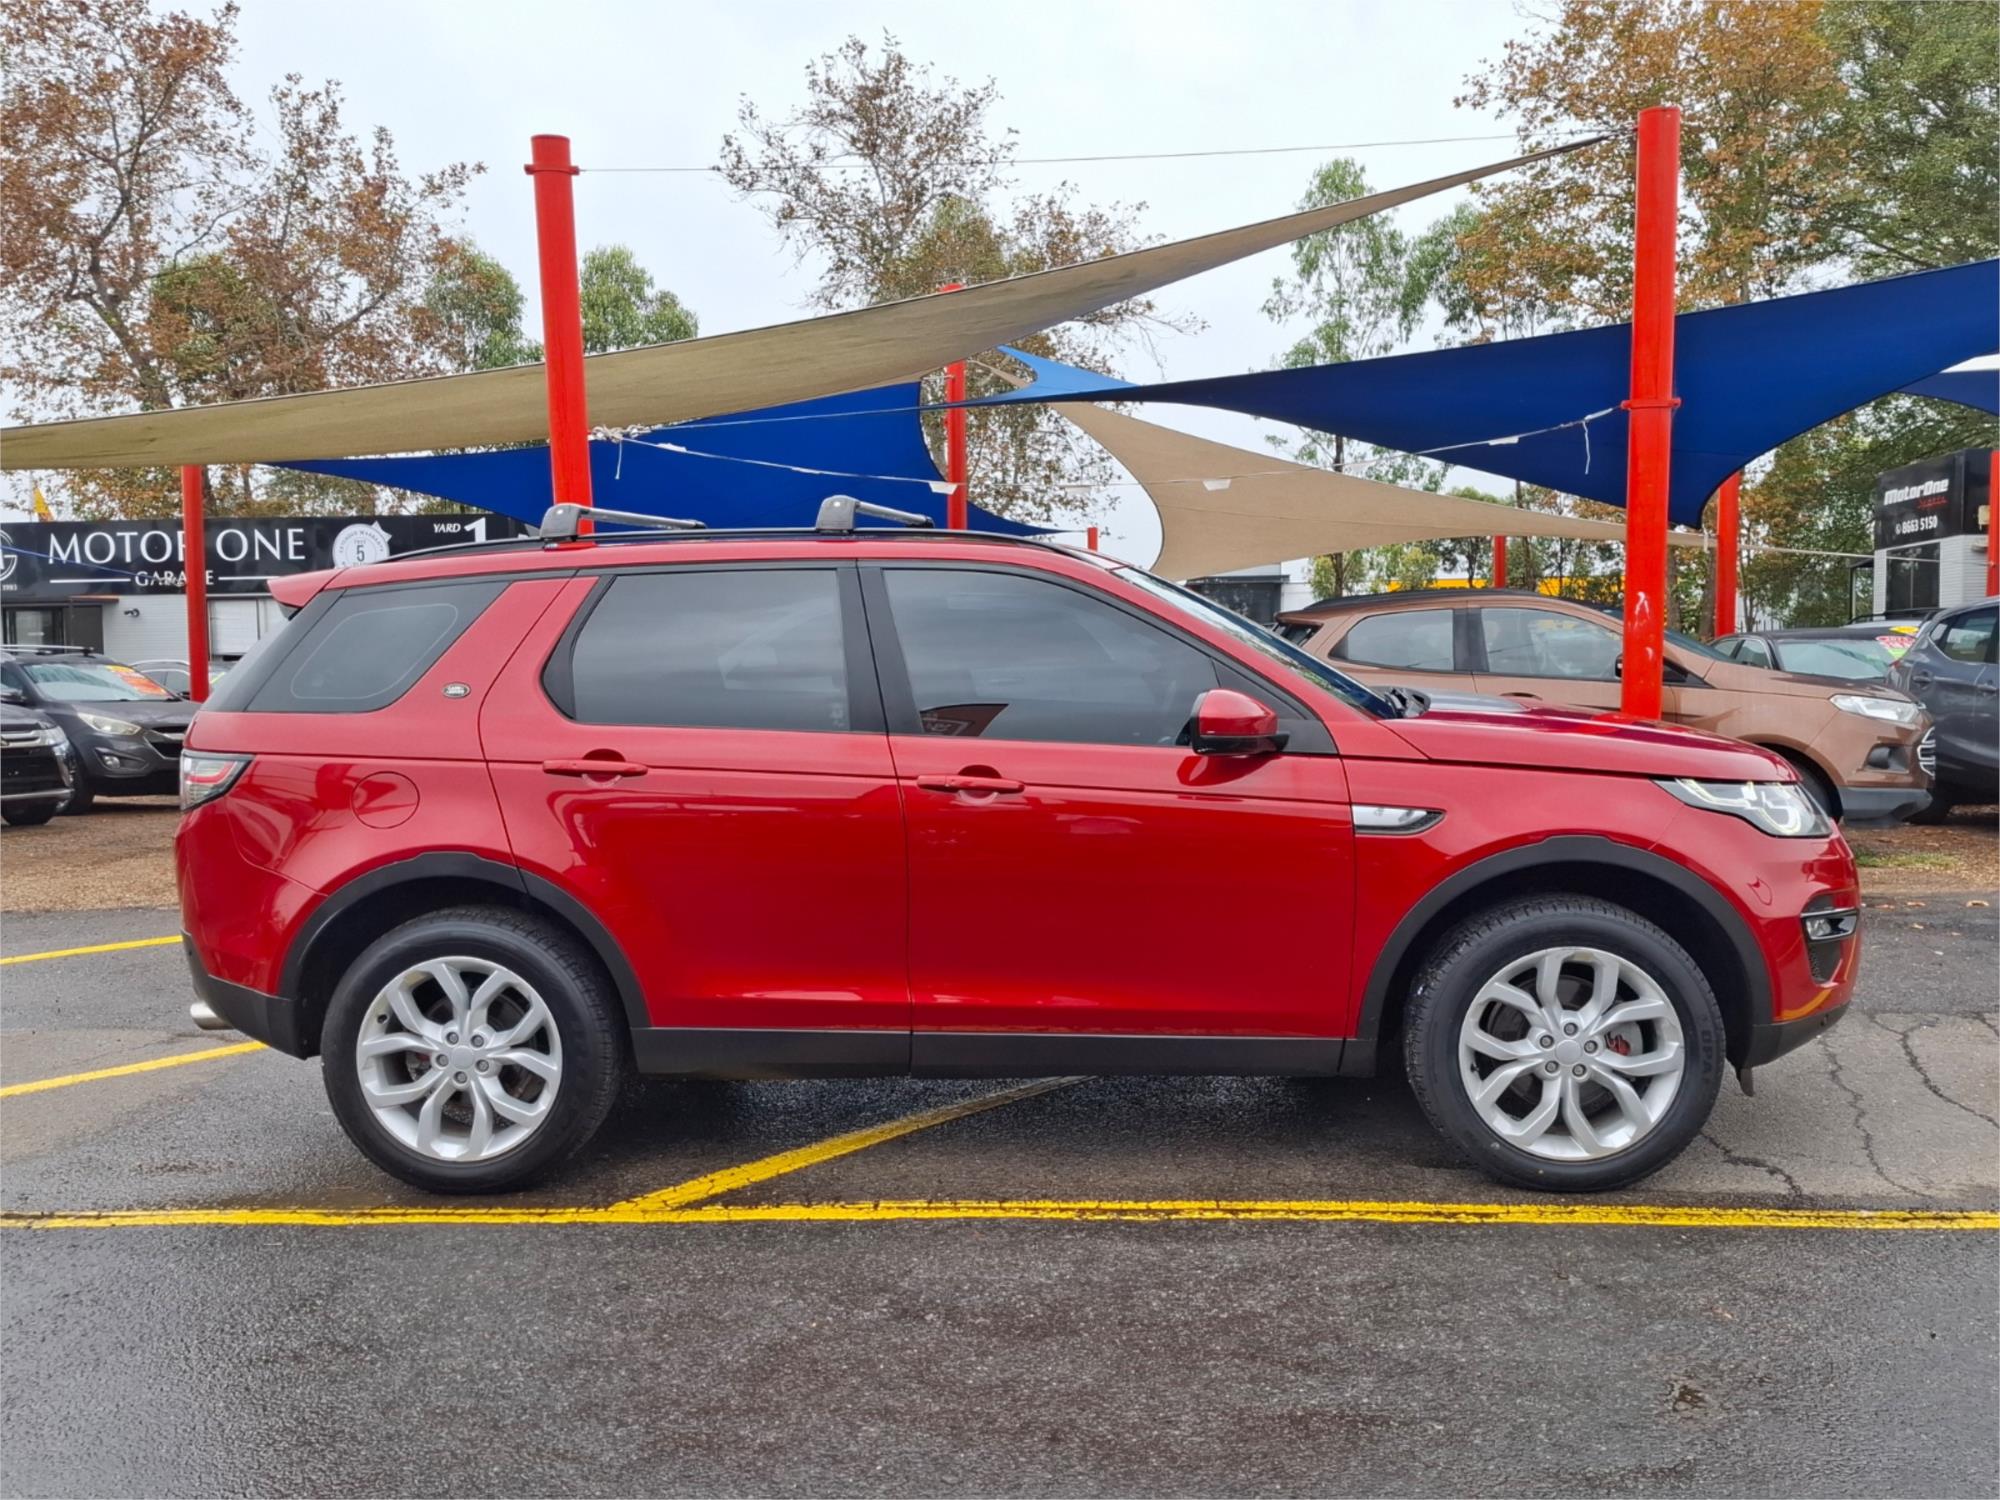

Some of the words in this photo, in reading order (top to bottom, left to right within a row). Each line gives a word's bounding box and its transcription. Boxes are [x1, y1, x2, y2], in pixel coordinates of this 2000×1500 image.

[433, 523, 460, 533] YARD
[464, 517, 486, 542] 1
[1920, 515, 1937, 531] 5150
[216, 528, 305, 561] ONE
[356, 544, 365, 562] 5
[135, 569, 214, 587] GARAE
